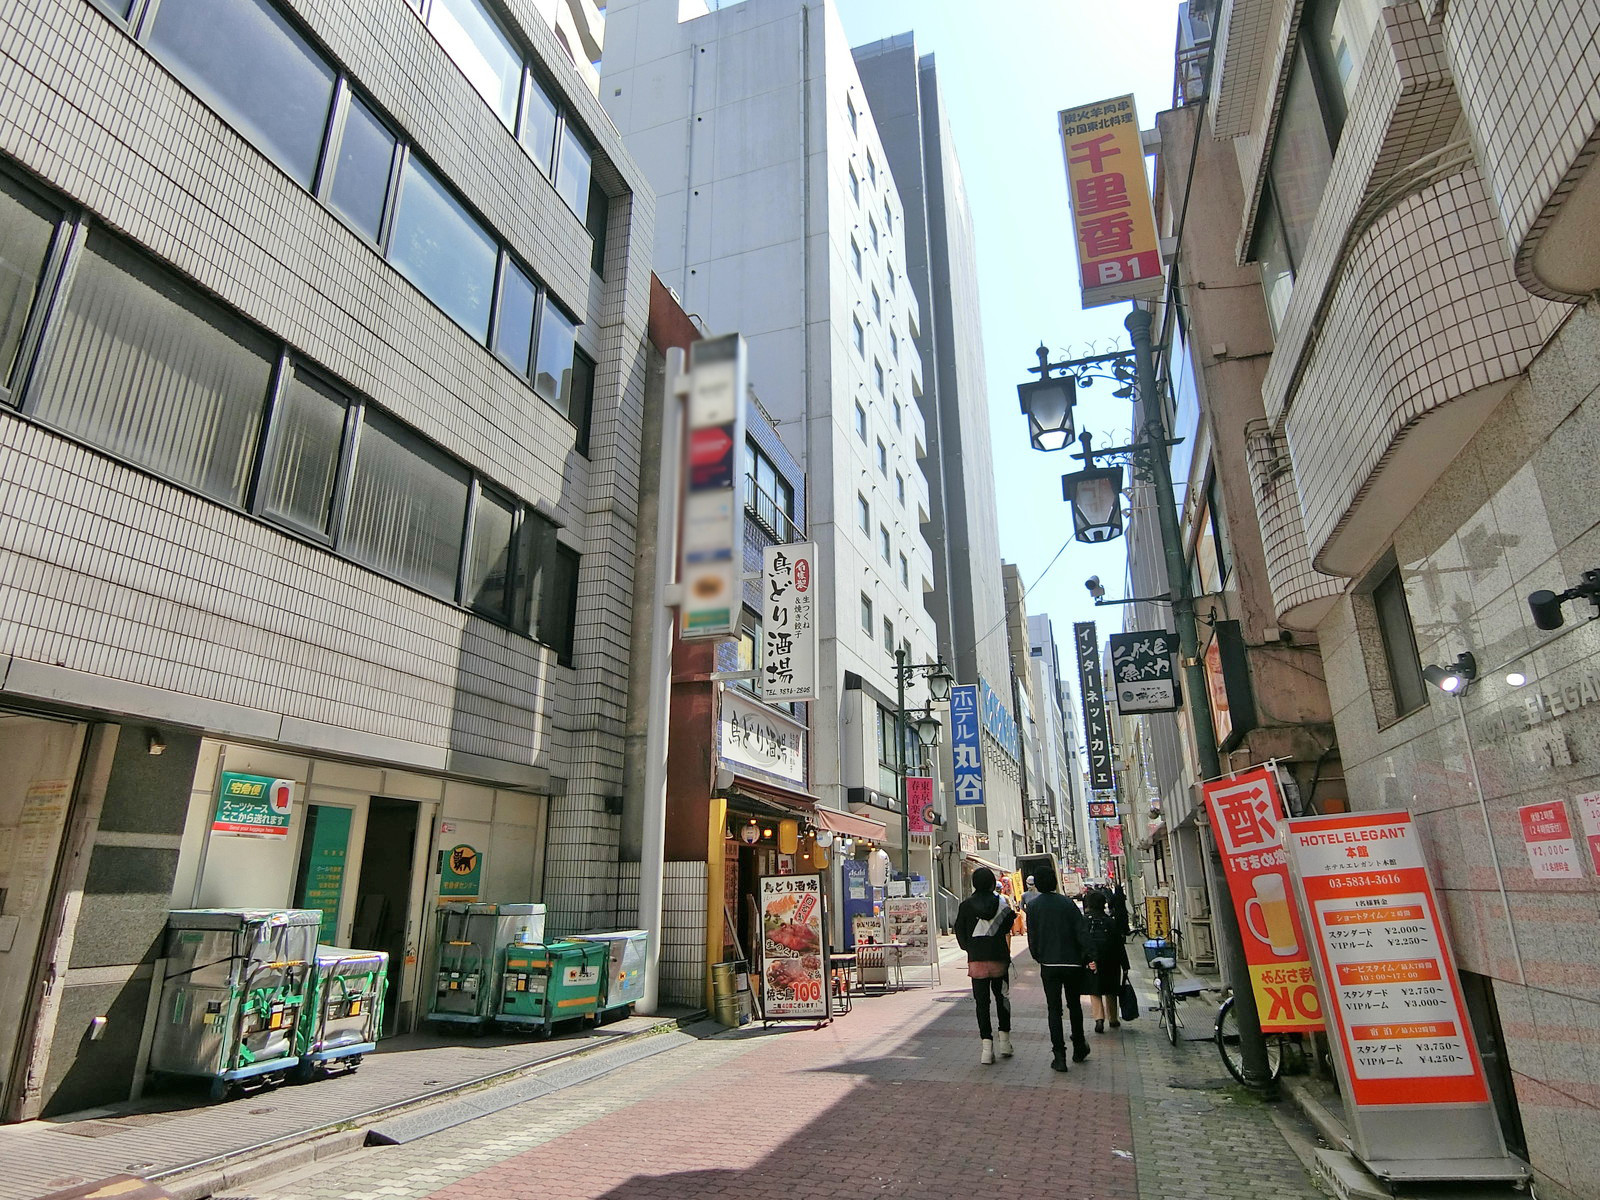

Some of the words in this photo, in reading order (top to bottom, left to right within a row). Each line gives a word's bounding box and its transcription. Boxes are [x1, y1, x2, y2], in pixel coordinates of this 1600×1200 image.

[1064, 100, 1130, 125] 炭火羊肉串
[1065, 112, 1133, 137] 中国東北料理
[1070, 133, 1135, 258] 千里香
[1098, 257, 1141, 284] B1
[766, 551, 793, 684] 鳥どり酒場
[802, 595, 810, 629] 生つくね
[1079, 628, 1108, 783] インターネットカフェ
[953, 690, 982, 801] ホテル丸谷
[230, 782, 262, 796] 宅急便
[223, 800, 268, 813] スーツケース
[221, 811, 285, 826] ここから送れます
[1300, 833, 1344, 847] HOTEL
[1344, 827, 1406, 843] ELEGANT
[1345, 845, 1369, 859] 本館
[1324, 858, 1397, 871] ホテルエレガント本館
[763, 879, 818, 894] 鳥どり酒場
[1329, 873, 1401, 889] 03-5834-3616
[1328, 928, 1373, 939] スタンダード
[1331, 940, 1373, 949] VIPルーム
[1343, 989, 1388, 999] スタンダード
[1346, 1001, 1389, 1011] VIPルーム
[1357, 1044, 1402, 1054] スタンダード
[1359, 1057, 1403, 1066] VIPルーム
